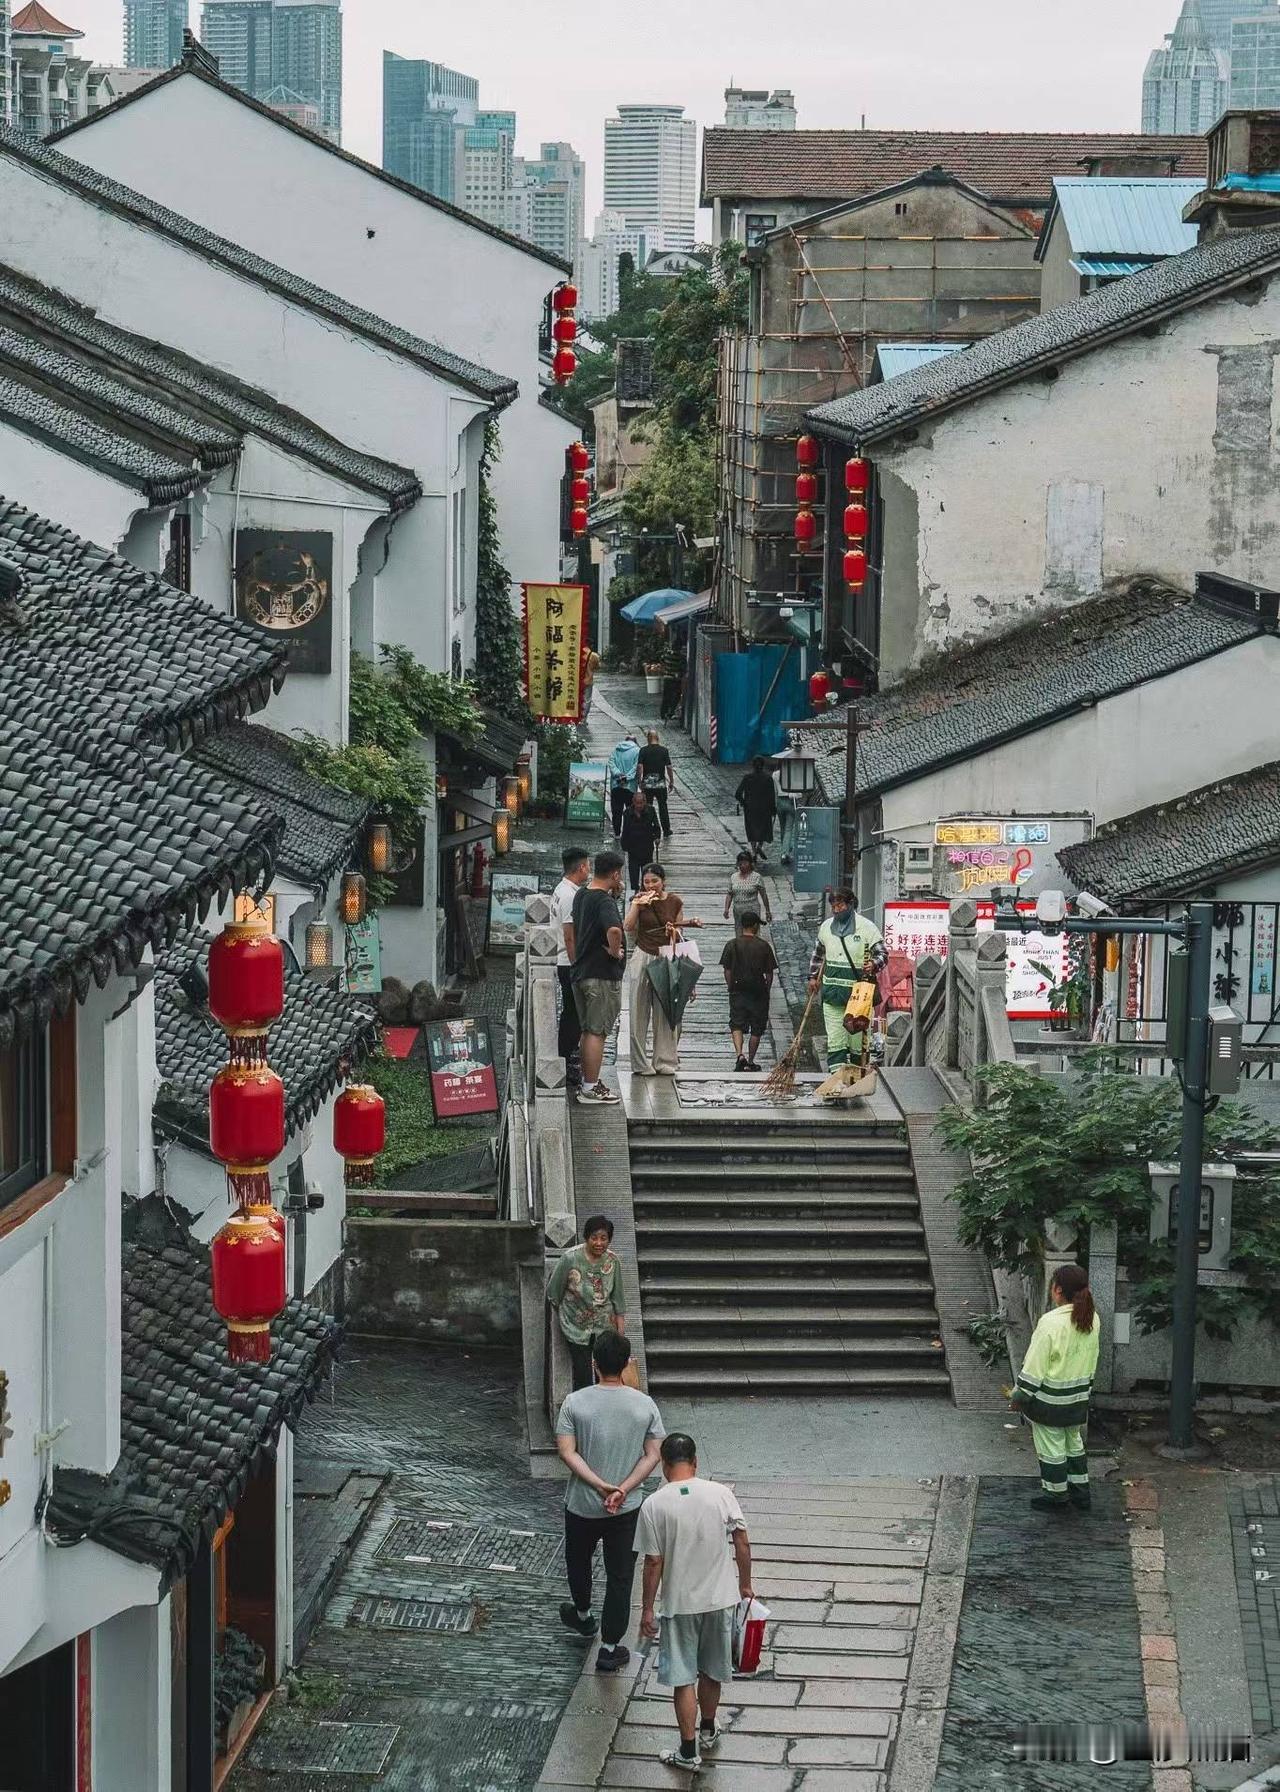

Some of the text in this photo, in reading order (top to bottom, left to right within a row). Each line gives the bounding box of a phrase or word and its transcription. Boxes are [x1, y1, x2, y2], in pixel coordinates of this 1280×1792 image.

[938, 826, 999, 842] 哈基米
[949, 847, 1010, 865] 相信自己
[898, 934, 950, 946] 好彩连连
